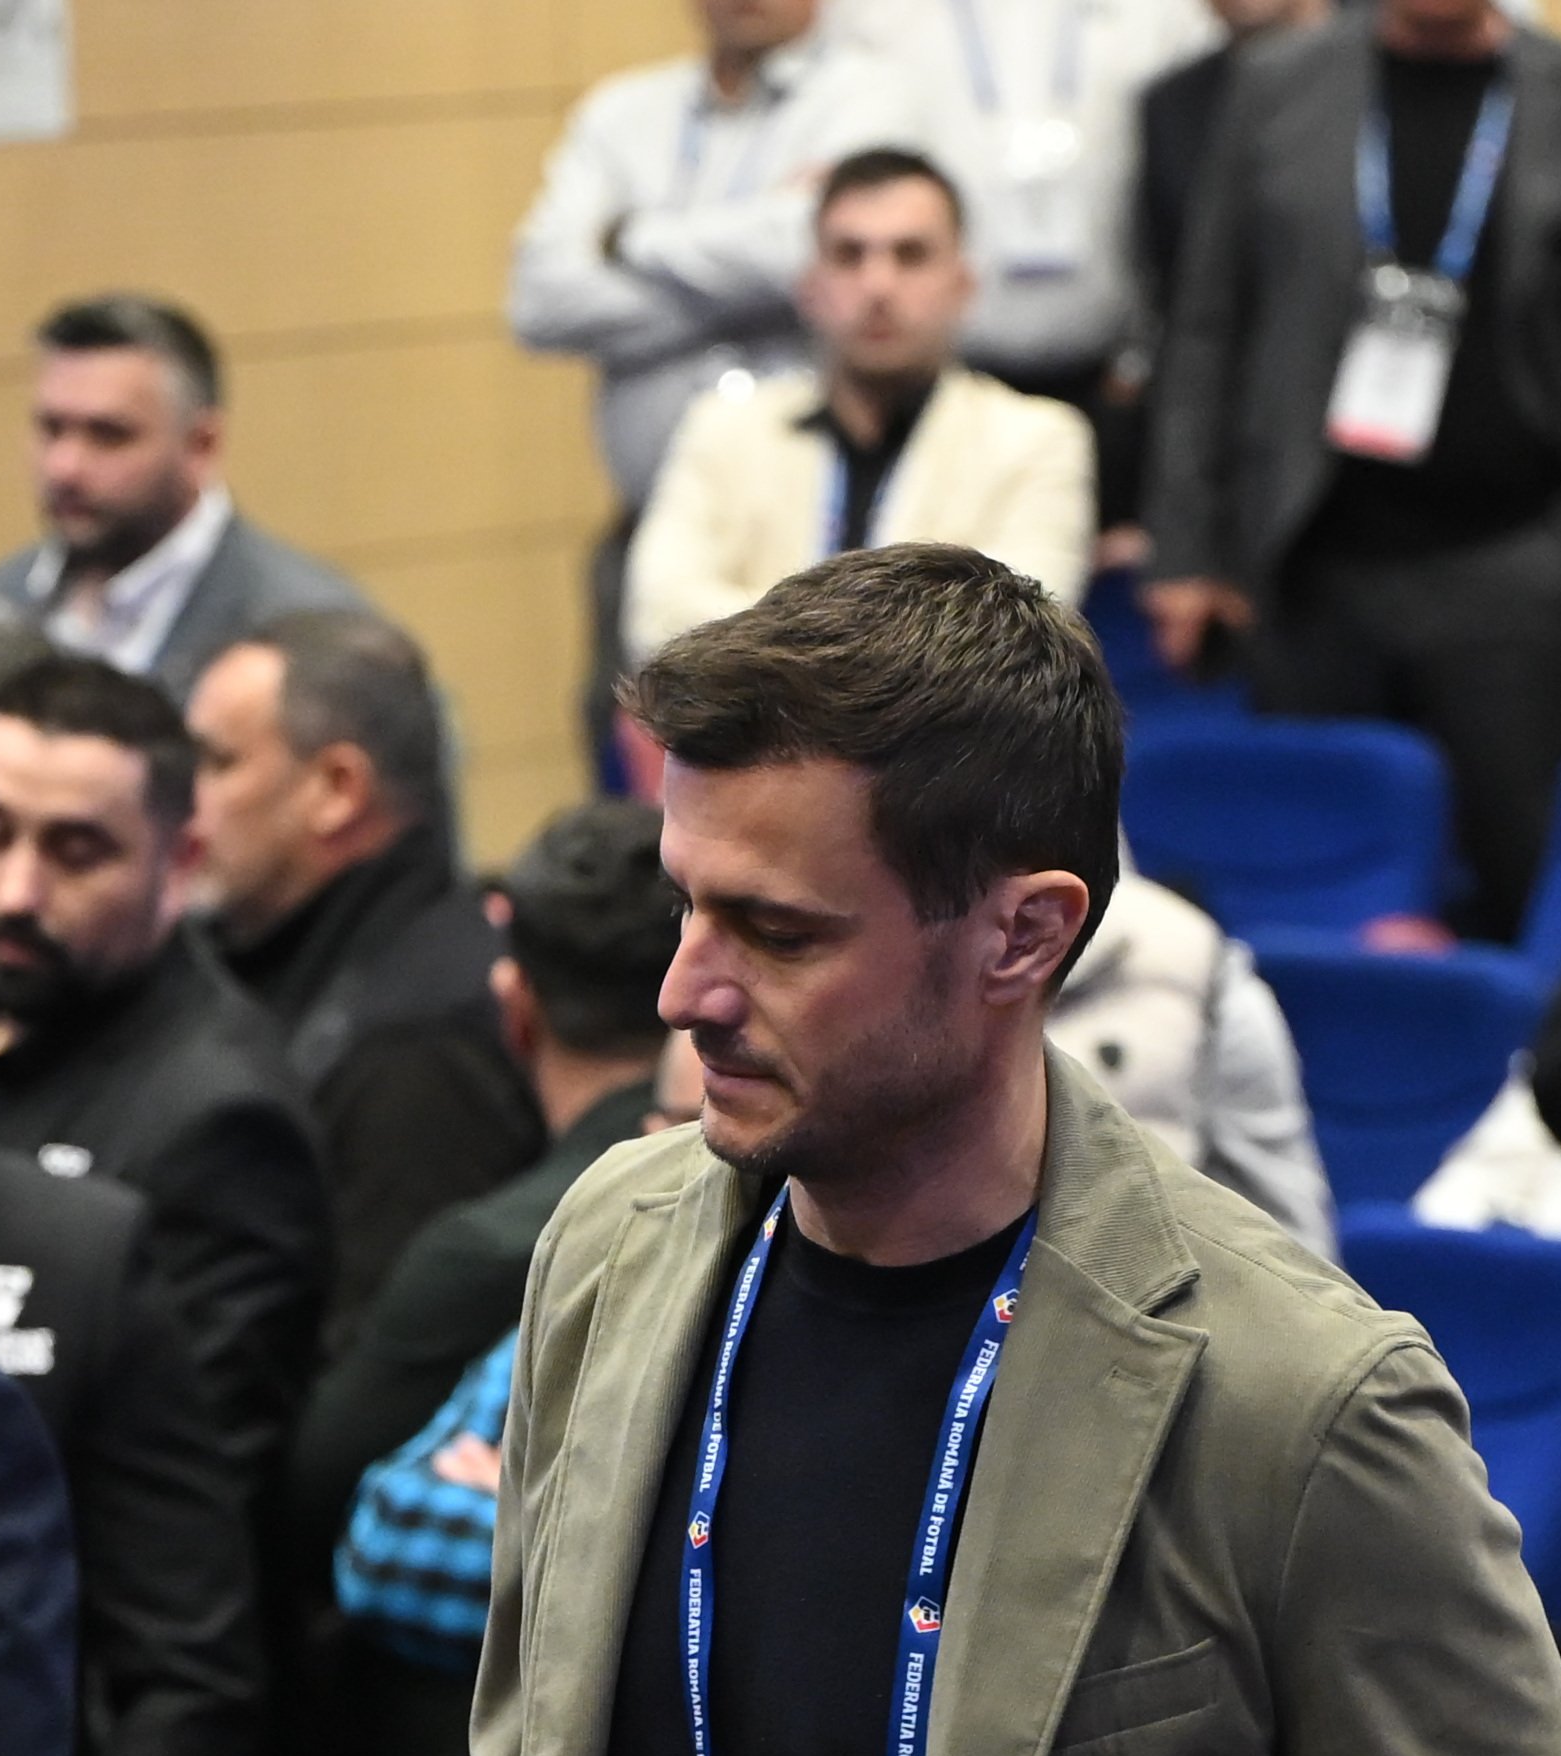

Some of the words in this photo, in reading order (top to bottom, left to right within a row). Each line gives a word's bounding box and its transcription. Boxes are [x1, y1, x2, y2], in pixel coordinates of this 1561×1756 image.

[712, 1411, 723, 1432] DE
[699, 1433, 723, 1493] FOTBAL
[934, 1492, 949, 1514] DE
[919, 1515, 946, 1577] FOTBAL
[695, 1730, 704, 1751] DE
